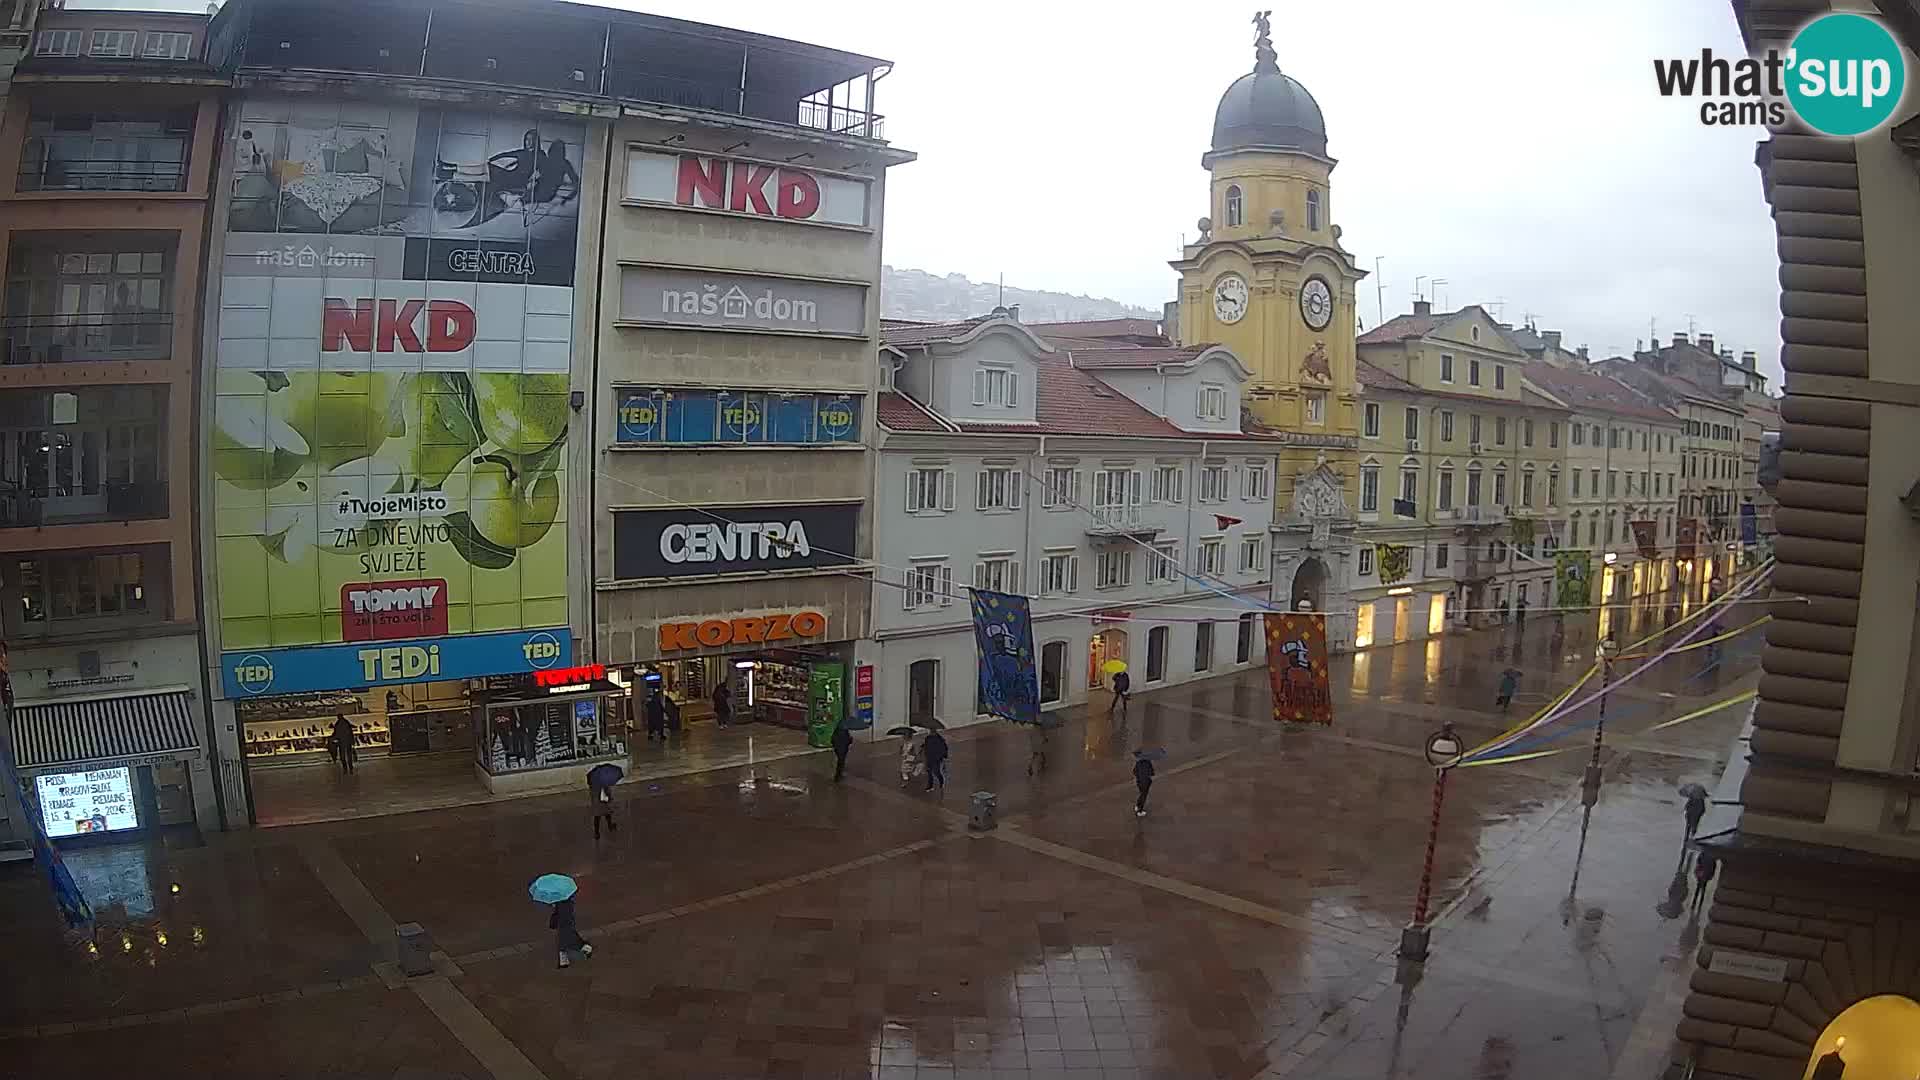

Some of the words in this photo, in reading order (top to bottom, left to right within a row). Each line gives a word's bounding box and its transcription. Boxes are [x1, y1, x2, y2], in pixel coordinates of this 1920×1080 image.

[676, 156, 821, 220] NKD
[256, 245, 295, 266] naš
[320, 247, 369, 268] dom
[449, 249, 535, 275] CENTRA
[662, 283, 718, 315] naš
[755, 290, 816, 322] dom
[322, 298, 477, 353] NKD
[620, 408, 658, 424] TEDi
[723, 408, 760, 425] TEDi
[820, 411, 852, 426] TEDi
[338, 496, 447, 515] #TvojeMisto
[334, 527, 358, 548] ZA
[367, 522, 452, 546] DNEVNO
[660, 520, 810, 564] CENTRA
[360, 550, 427, 574] SVJEŽE
[349, 586, 440, 613] TOMMY
[660, 611, 826, 650] KORZO
[358, 644, 441, 682] TEDi
[523, 641, 561, 661] TEDi
[233, 665, 274, 684] TEDi
